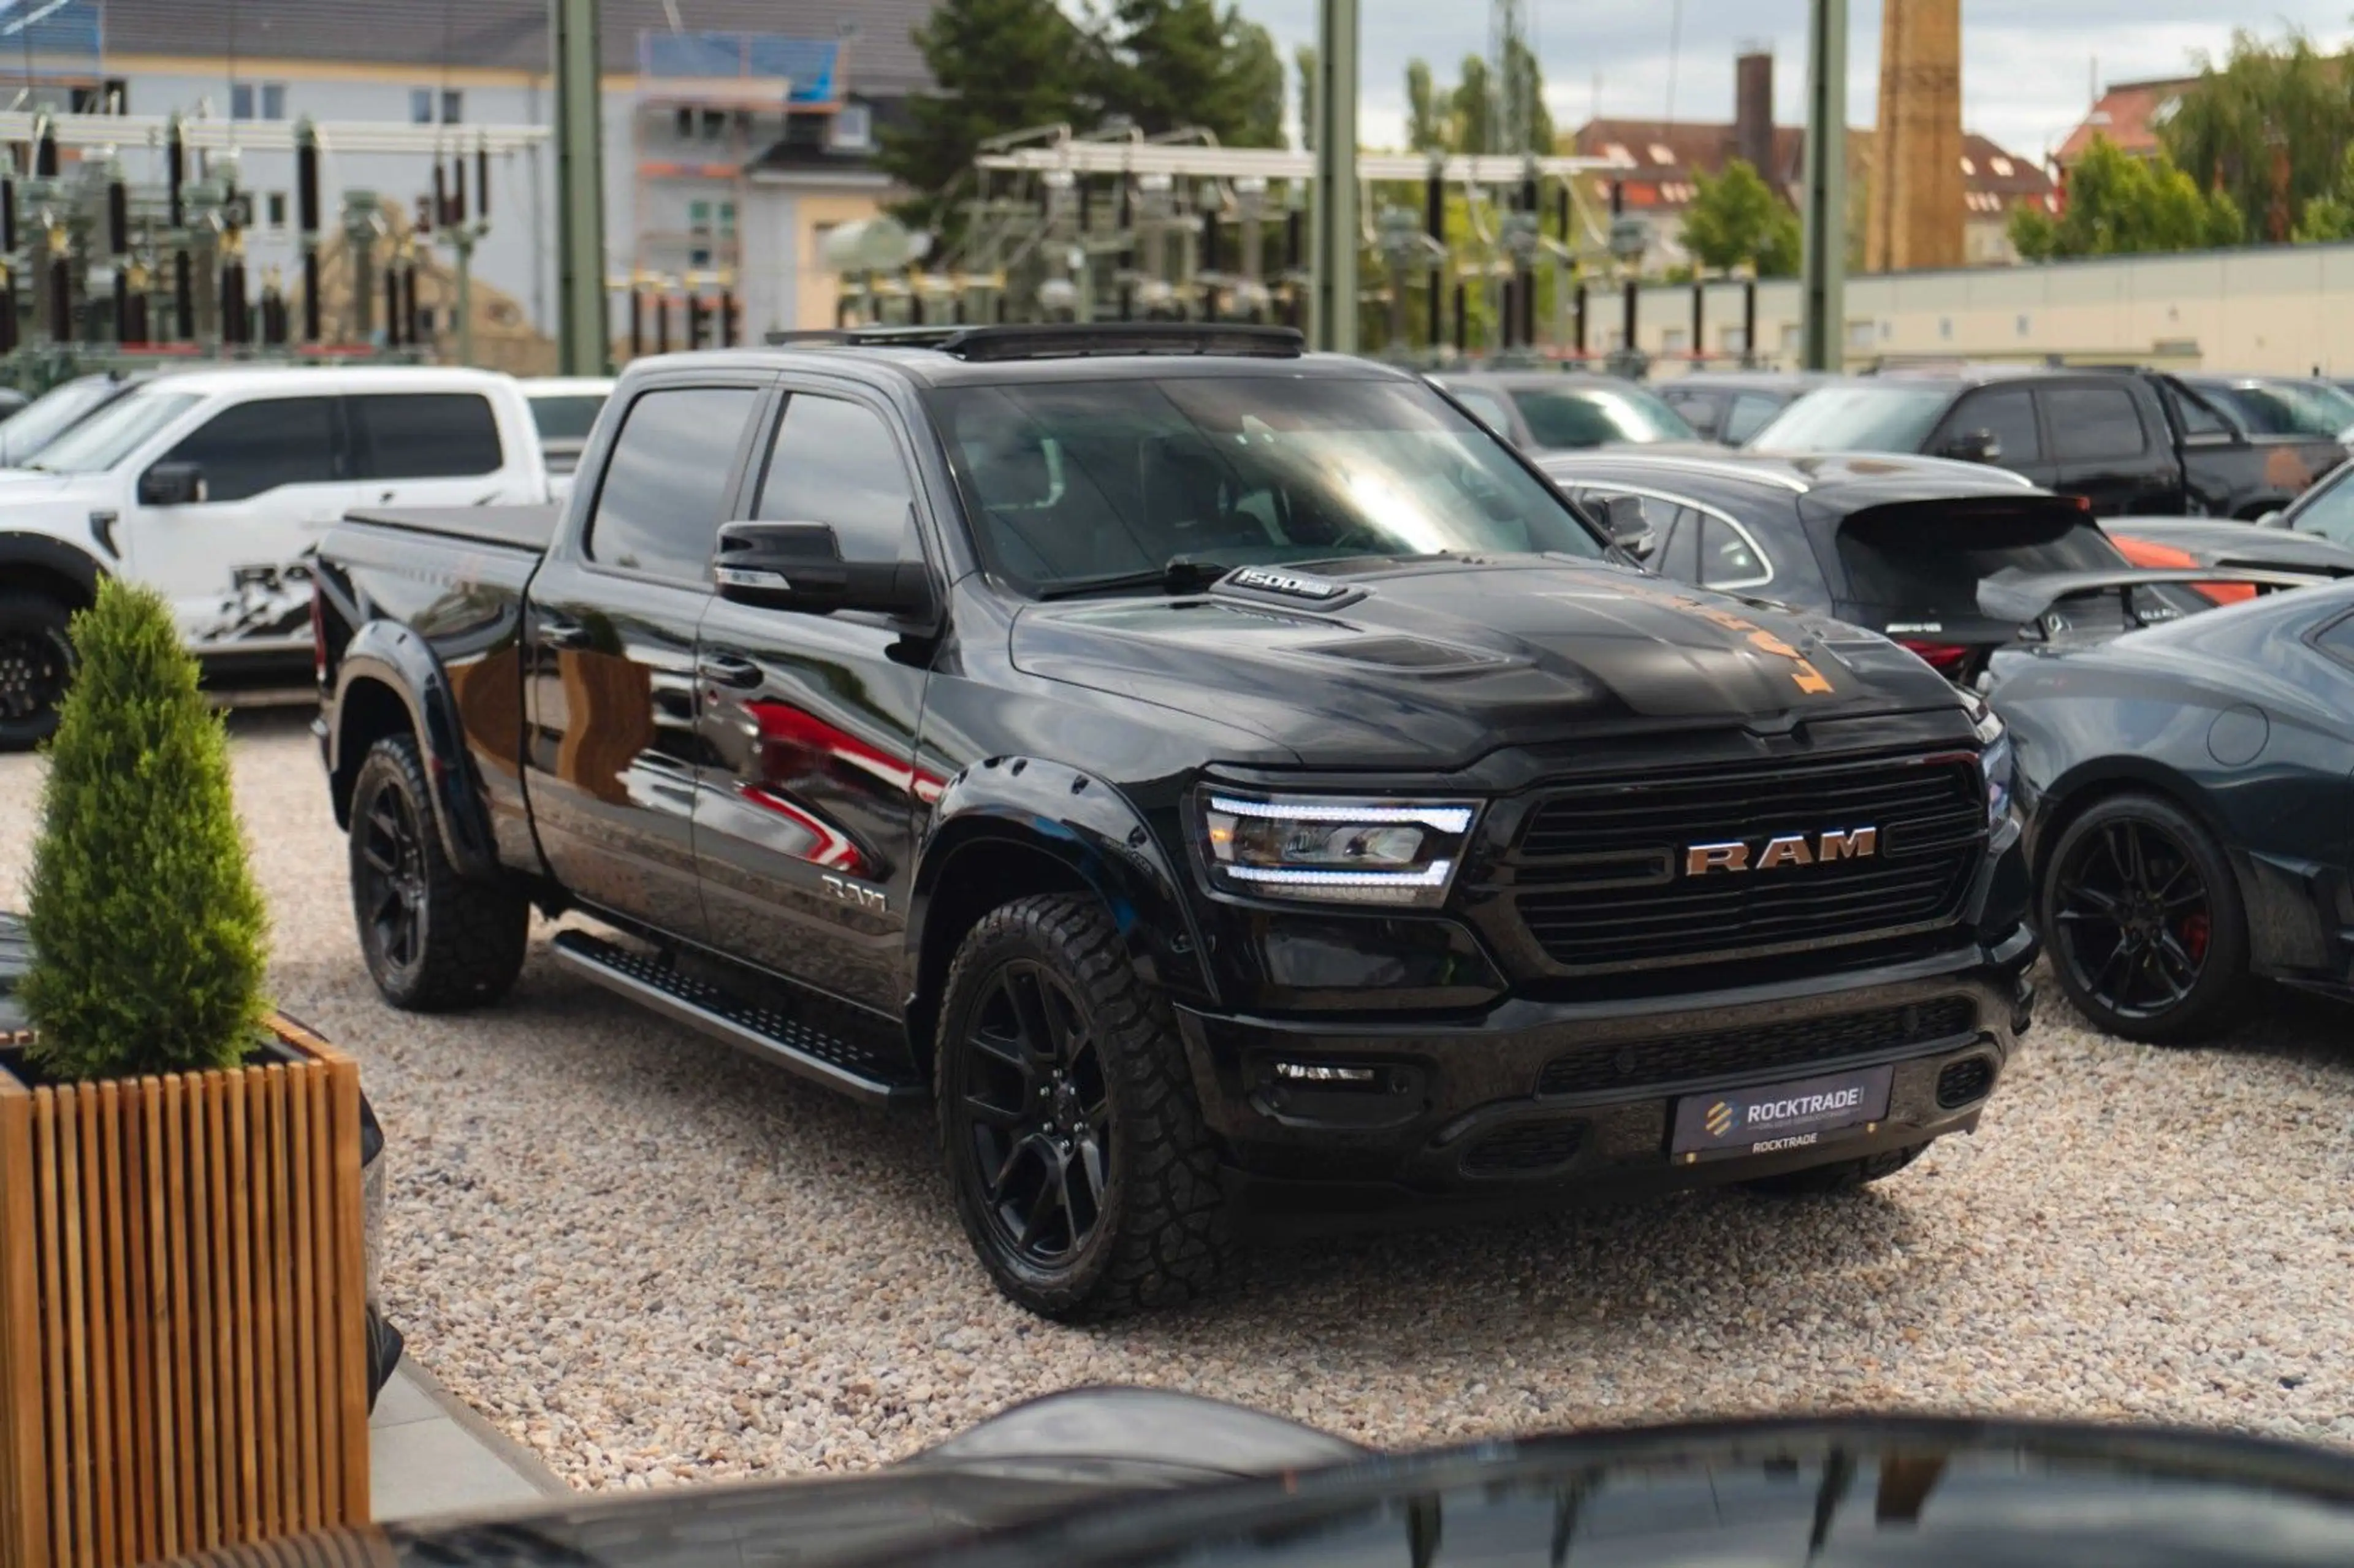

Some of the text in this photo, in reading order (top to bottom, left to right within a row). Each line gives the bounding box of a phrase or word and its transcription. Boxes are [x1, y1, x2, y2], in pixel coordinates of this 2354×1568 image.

[1686, 826, 1877, 877] RAM
[821, 874, 886, 913] RAM
[1747, 1087, 1859, 1123] ROCKTRADE
[1752, 1132, 1818, 1154] ROCKTRADE
